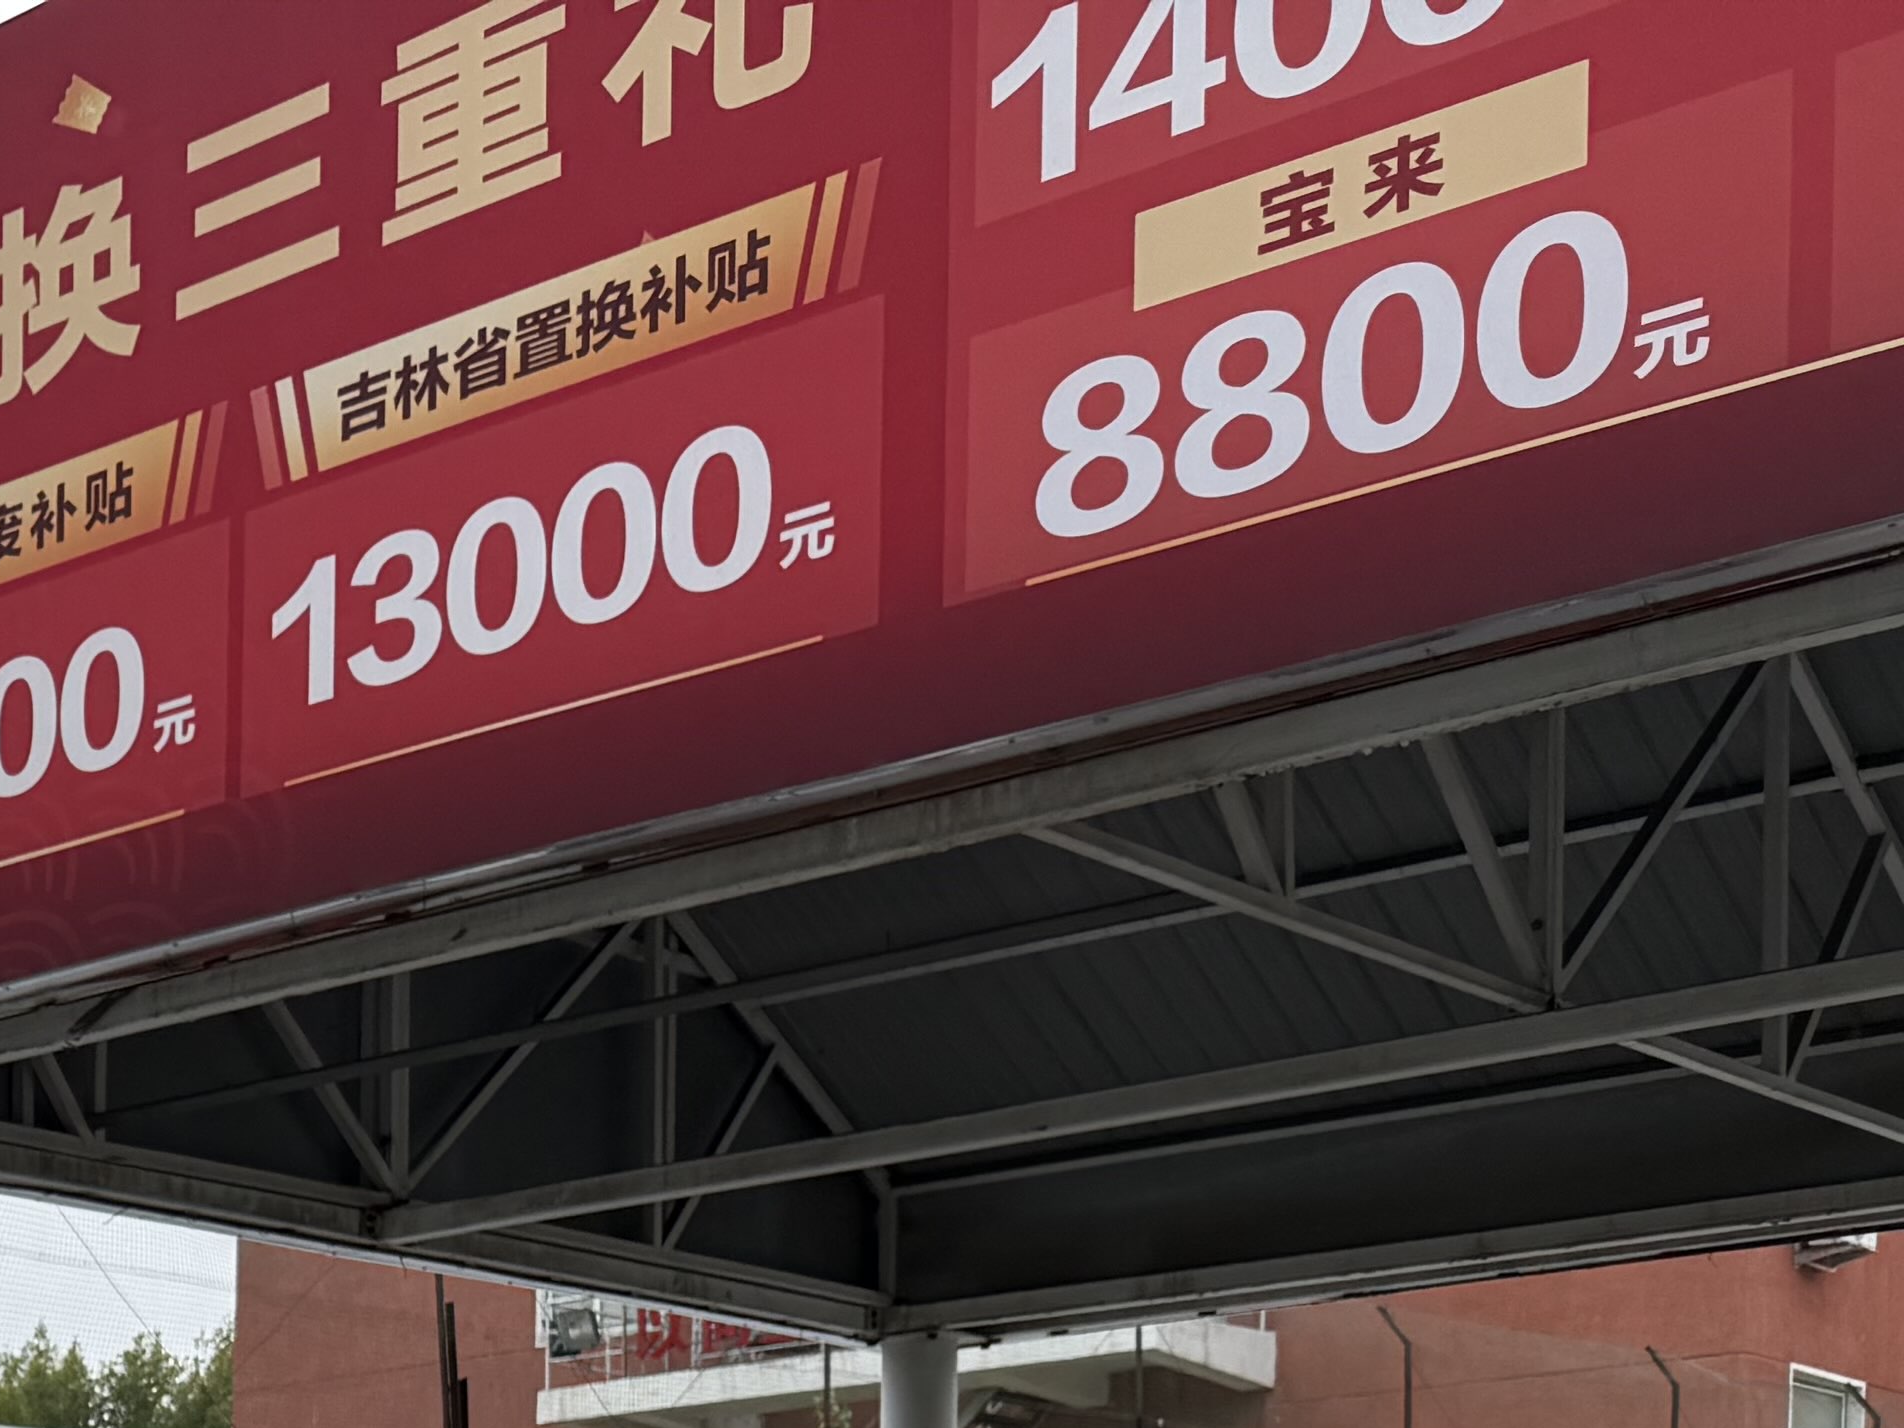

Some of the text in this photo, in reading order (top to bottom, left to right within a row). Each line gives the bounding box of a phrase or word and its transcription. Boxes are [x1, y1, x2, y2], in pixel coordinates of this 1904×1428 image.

[1257, 130, 1445, 256] 宝来
[337, 226, 772, 442] 吉林省置换补贴
